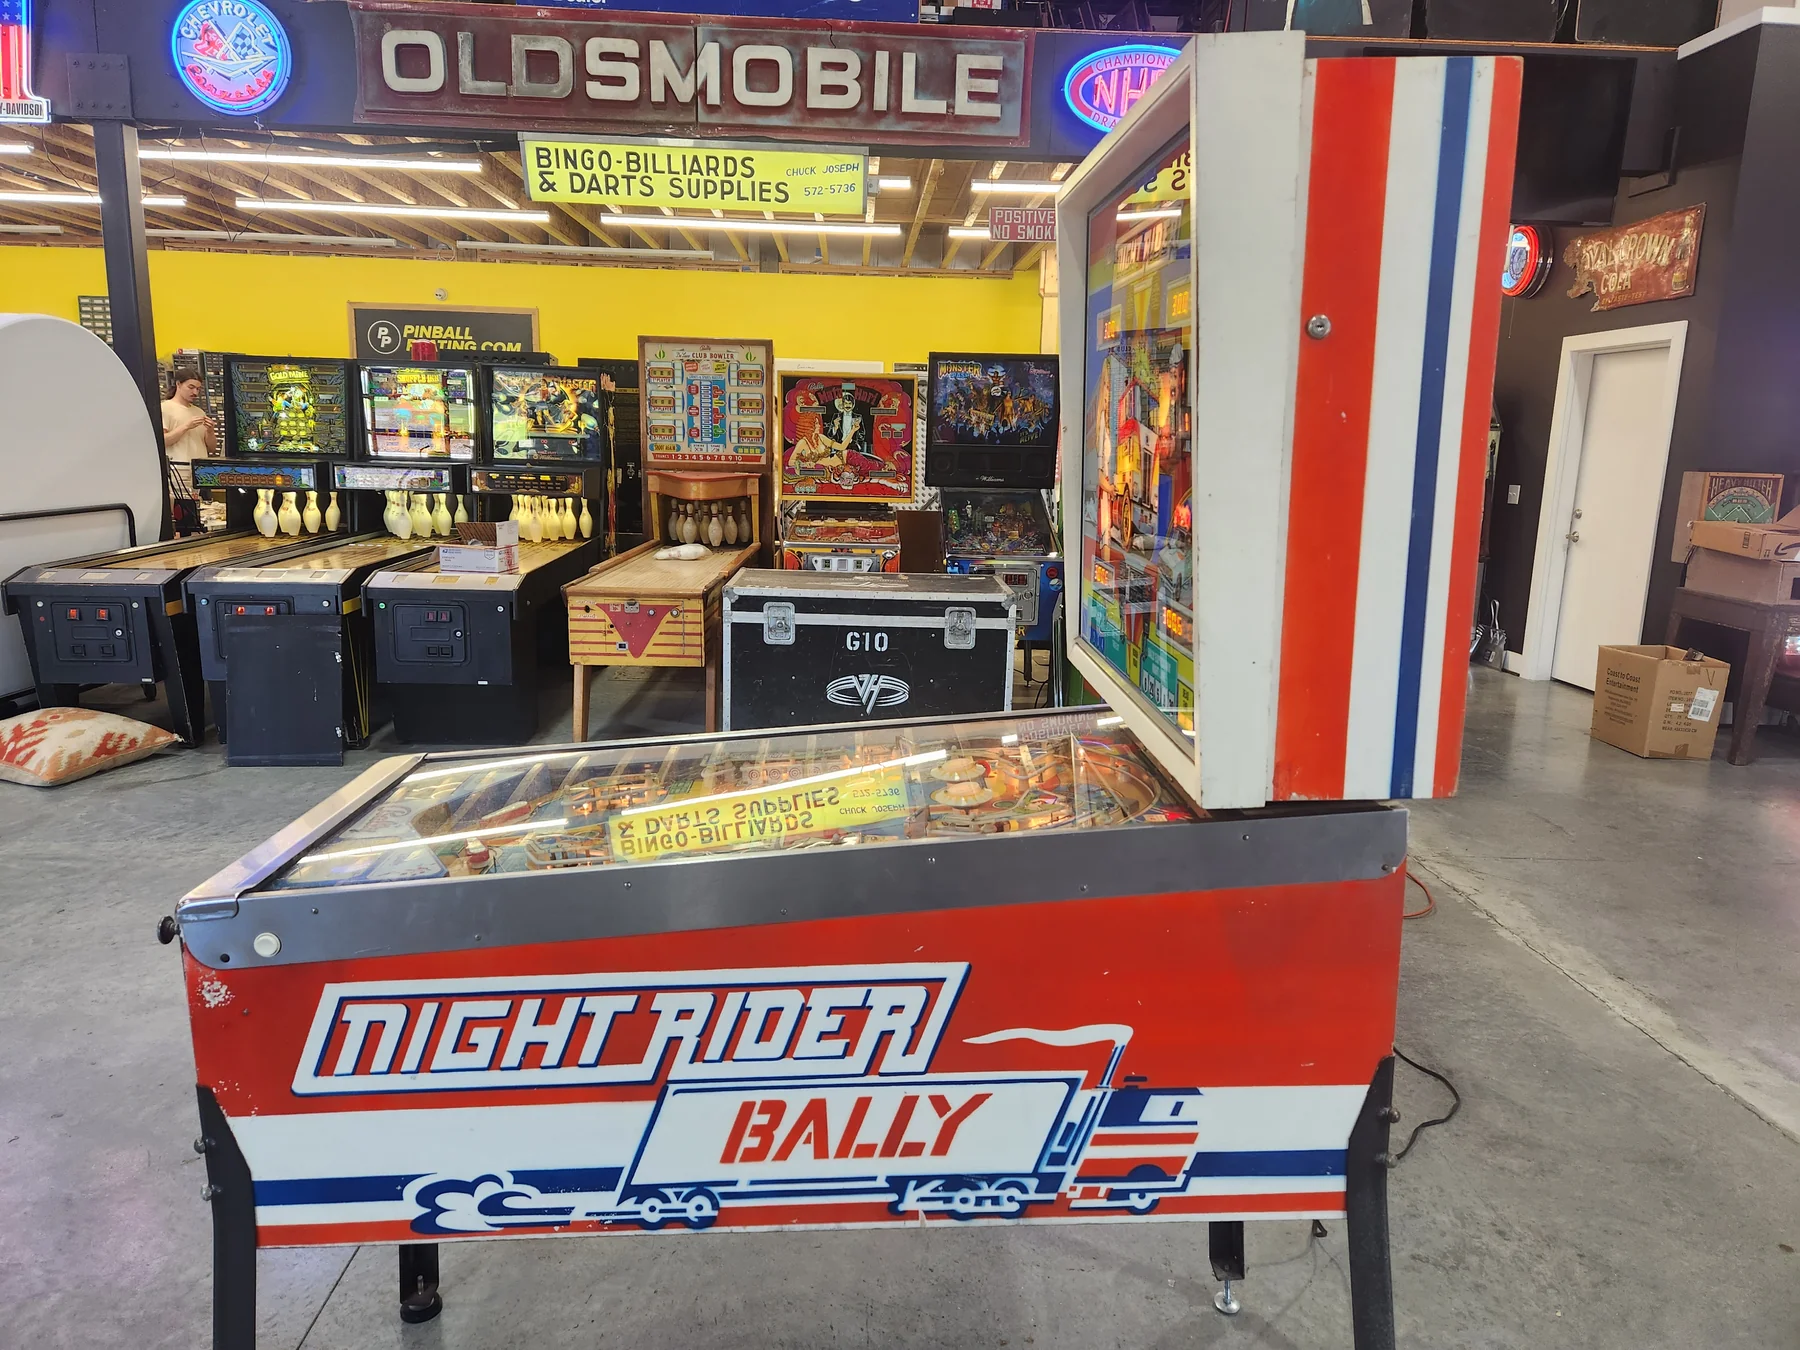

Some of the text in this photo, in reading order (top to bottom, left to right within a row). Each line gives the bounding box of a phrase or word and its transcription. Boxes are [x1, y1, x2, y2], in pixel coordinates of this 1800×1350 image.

[181, 0, 276, 46] CHEVROLET
[381, 29, 1004, 118] OLDSMOBILE
[535, 146, 755, 179] BINGO-BILLIARDS
[785, 162, 860, 177] CHUCK JOSEPH
[538, 170, 790, 204] & DARTS SUPPLIES
[803, 182, 857, 197] 572-5736
[992, 224, 1010, 239] NO
[1620, 232, 1676, 267] CROWN
[403, 324, 473, 340] PINBALL
[270, 371, 288, 381] GOLD
[938, 362, 982, 379] MONSTER
[1710, 477, 1739, 500] HEAVY
[1605, 677, 1639, 694] Entertainment
[1606, 667, 1620, 678] Coast
[1626, 672, 1641, 684] Coast
[333, 986, 928, 1077] NIGHT RIDER
[720, 1092, 993, 1165] BALLY
